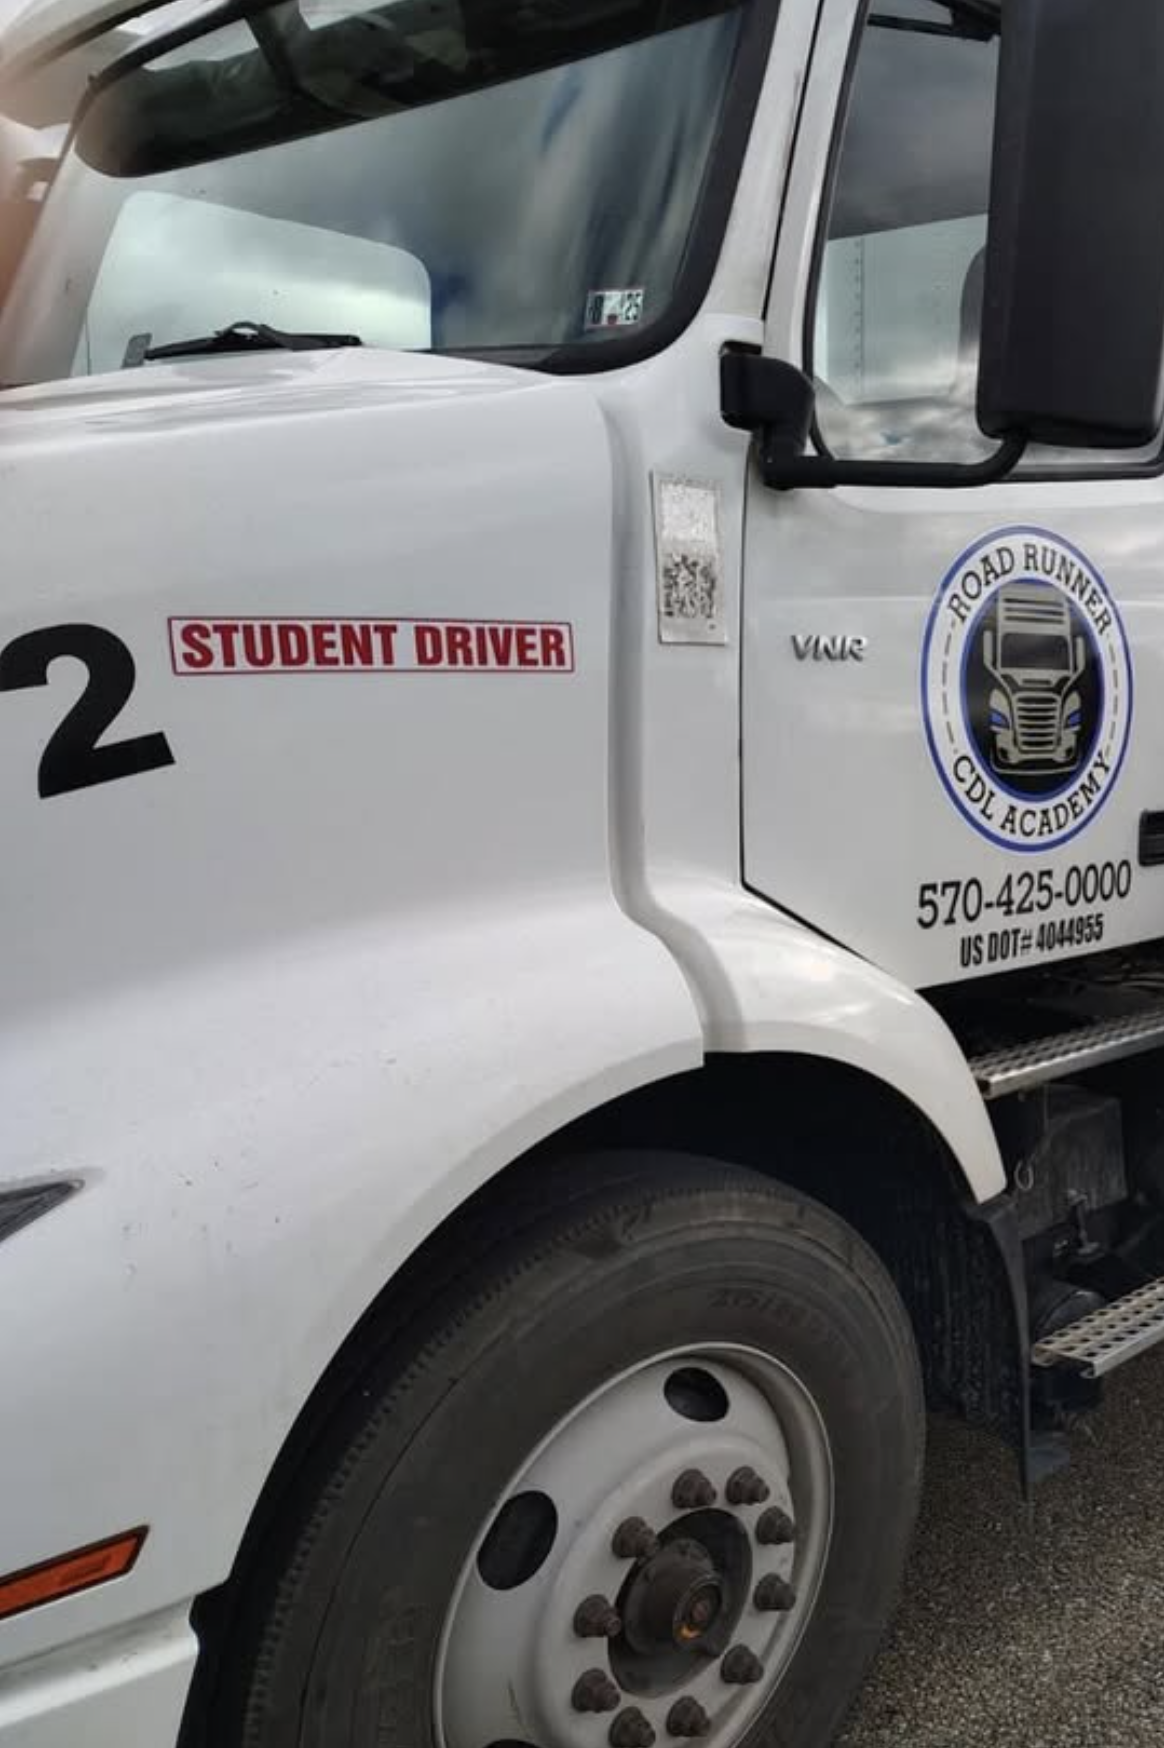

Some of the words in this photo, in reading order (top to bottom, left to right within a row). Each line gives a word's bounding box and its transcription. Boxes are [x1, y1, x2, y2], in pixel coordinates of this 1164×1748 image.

[625, 291, 642, 321] 25
[947, 546, 1015, 622] ROAD
[1024, 544, 1112, 635] RUNNER
[180, 623, 398, 668] STUDENT
[414, 625, 567, 667] DRIVER
[789, 634, 865, 662] VNR
[0, 623, 175, 799] 2
[953, 755, 995, 821] CDL
[1000, 750, 1110, 837] ACADEMY
[917, 860, 1132, 929] 570-425-0000
[960, 933, 985, 968] US
[988, 928, 1032, 962] DOT#
[1036, 914, 1104, 951] 4044955
